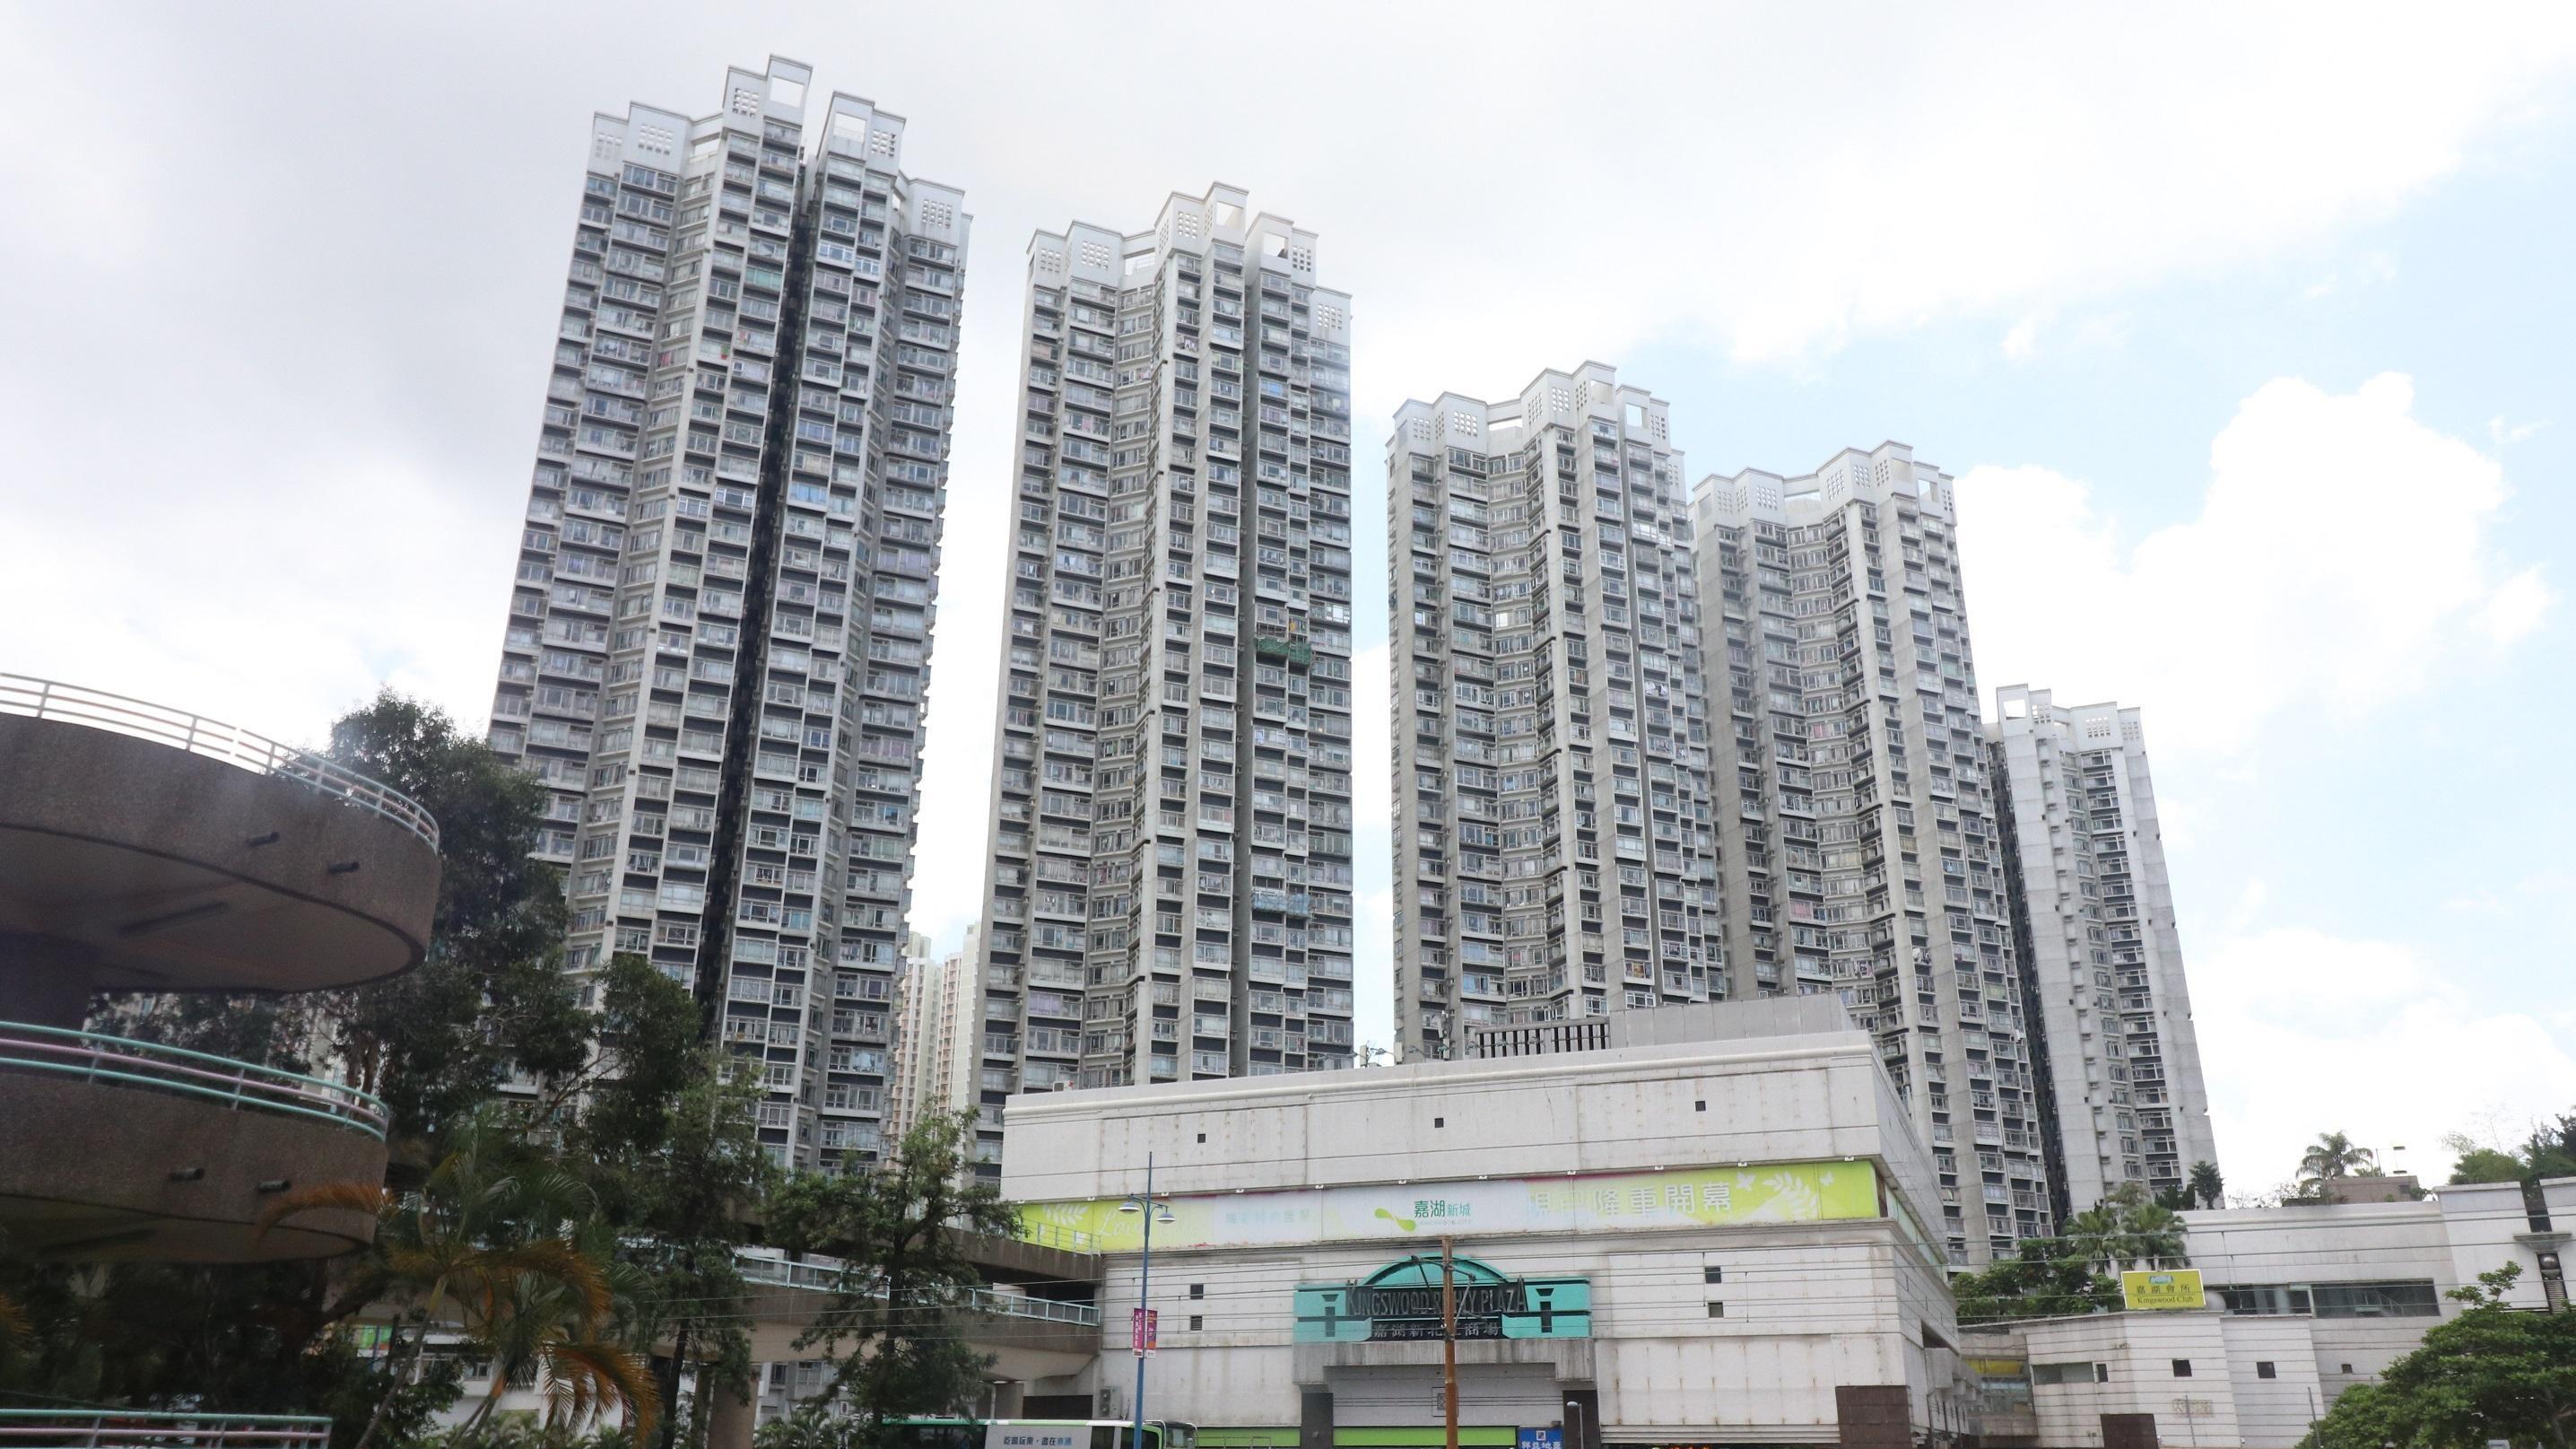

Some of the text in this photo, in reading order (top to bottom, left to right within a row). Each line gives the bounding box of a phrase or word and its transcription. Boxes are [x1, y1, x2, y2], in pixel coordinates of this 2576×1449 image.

[1414, 1200, 1471, 1218] 嘉湖新城
[1346, 1280, 1431, 1315] KINGSWOOD
[1481, 1279, 1527, 1313] PLAZA
[2137, 1284, 2190, 1294] 嘉湖會所
[2137, 1296, 2175, 1305] Kingswood
[1373, 1322, 1499, 1338] 嘉湖新北商場
